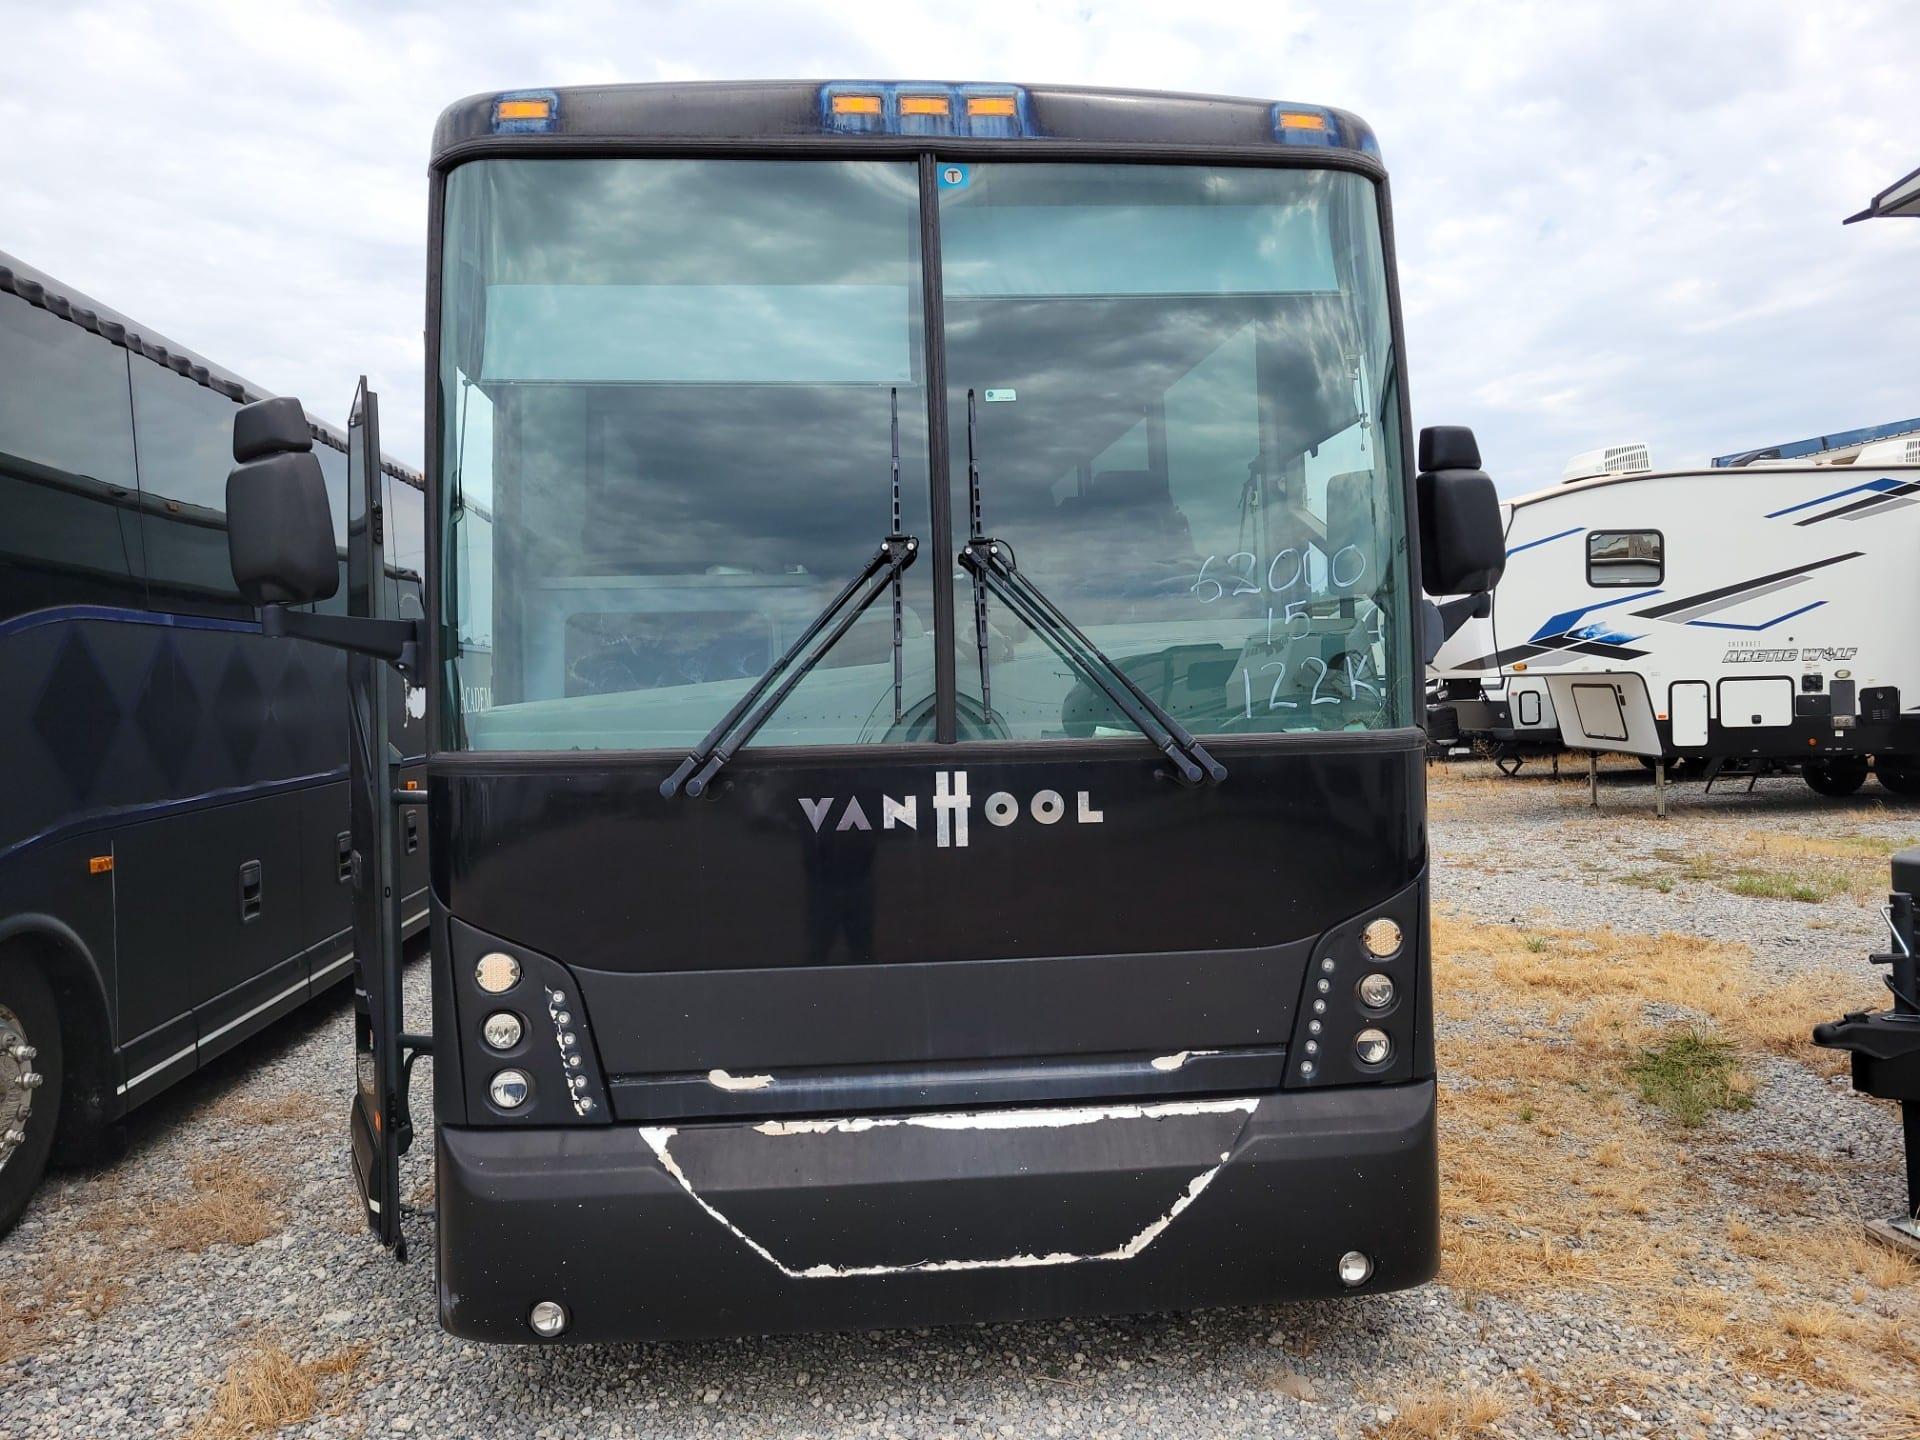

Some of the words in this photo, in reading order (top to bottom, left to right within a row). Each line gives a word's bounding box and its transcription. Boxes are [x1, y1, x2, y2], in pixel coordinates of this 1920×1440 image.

[1265, 600, 1312, 645] 15
[1722, 649, 1799, 664] ARCTIC
[1241, 654, 1382, 719] 122K
